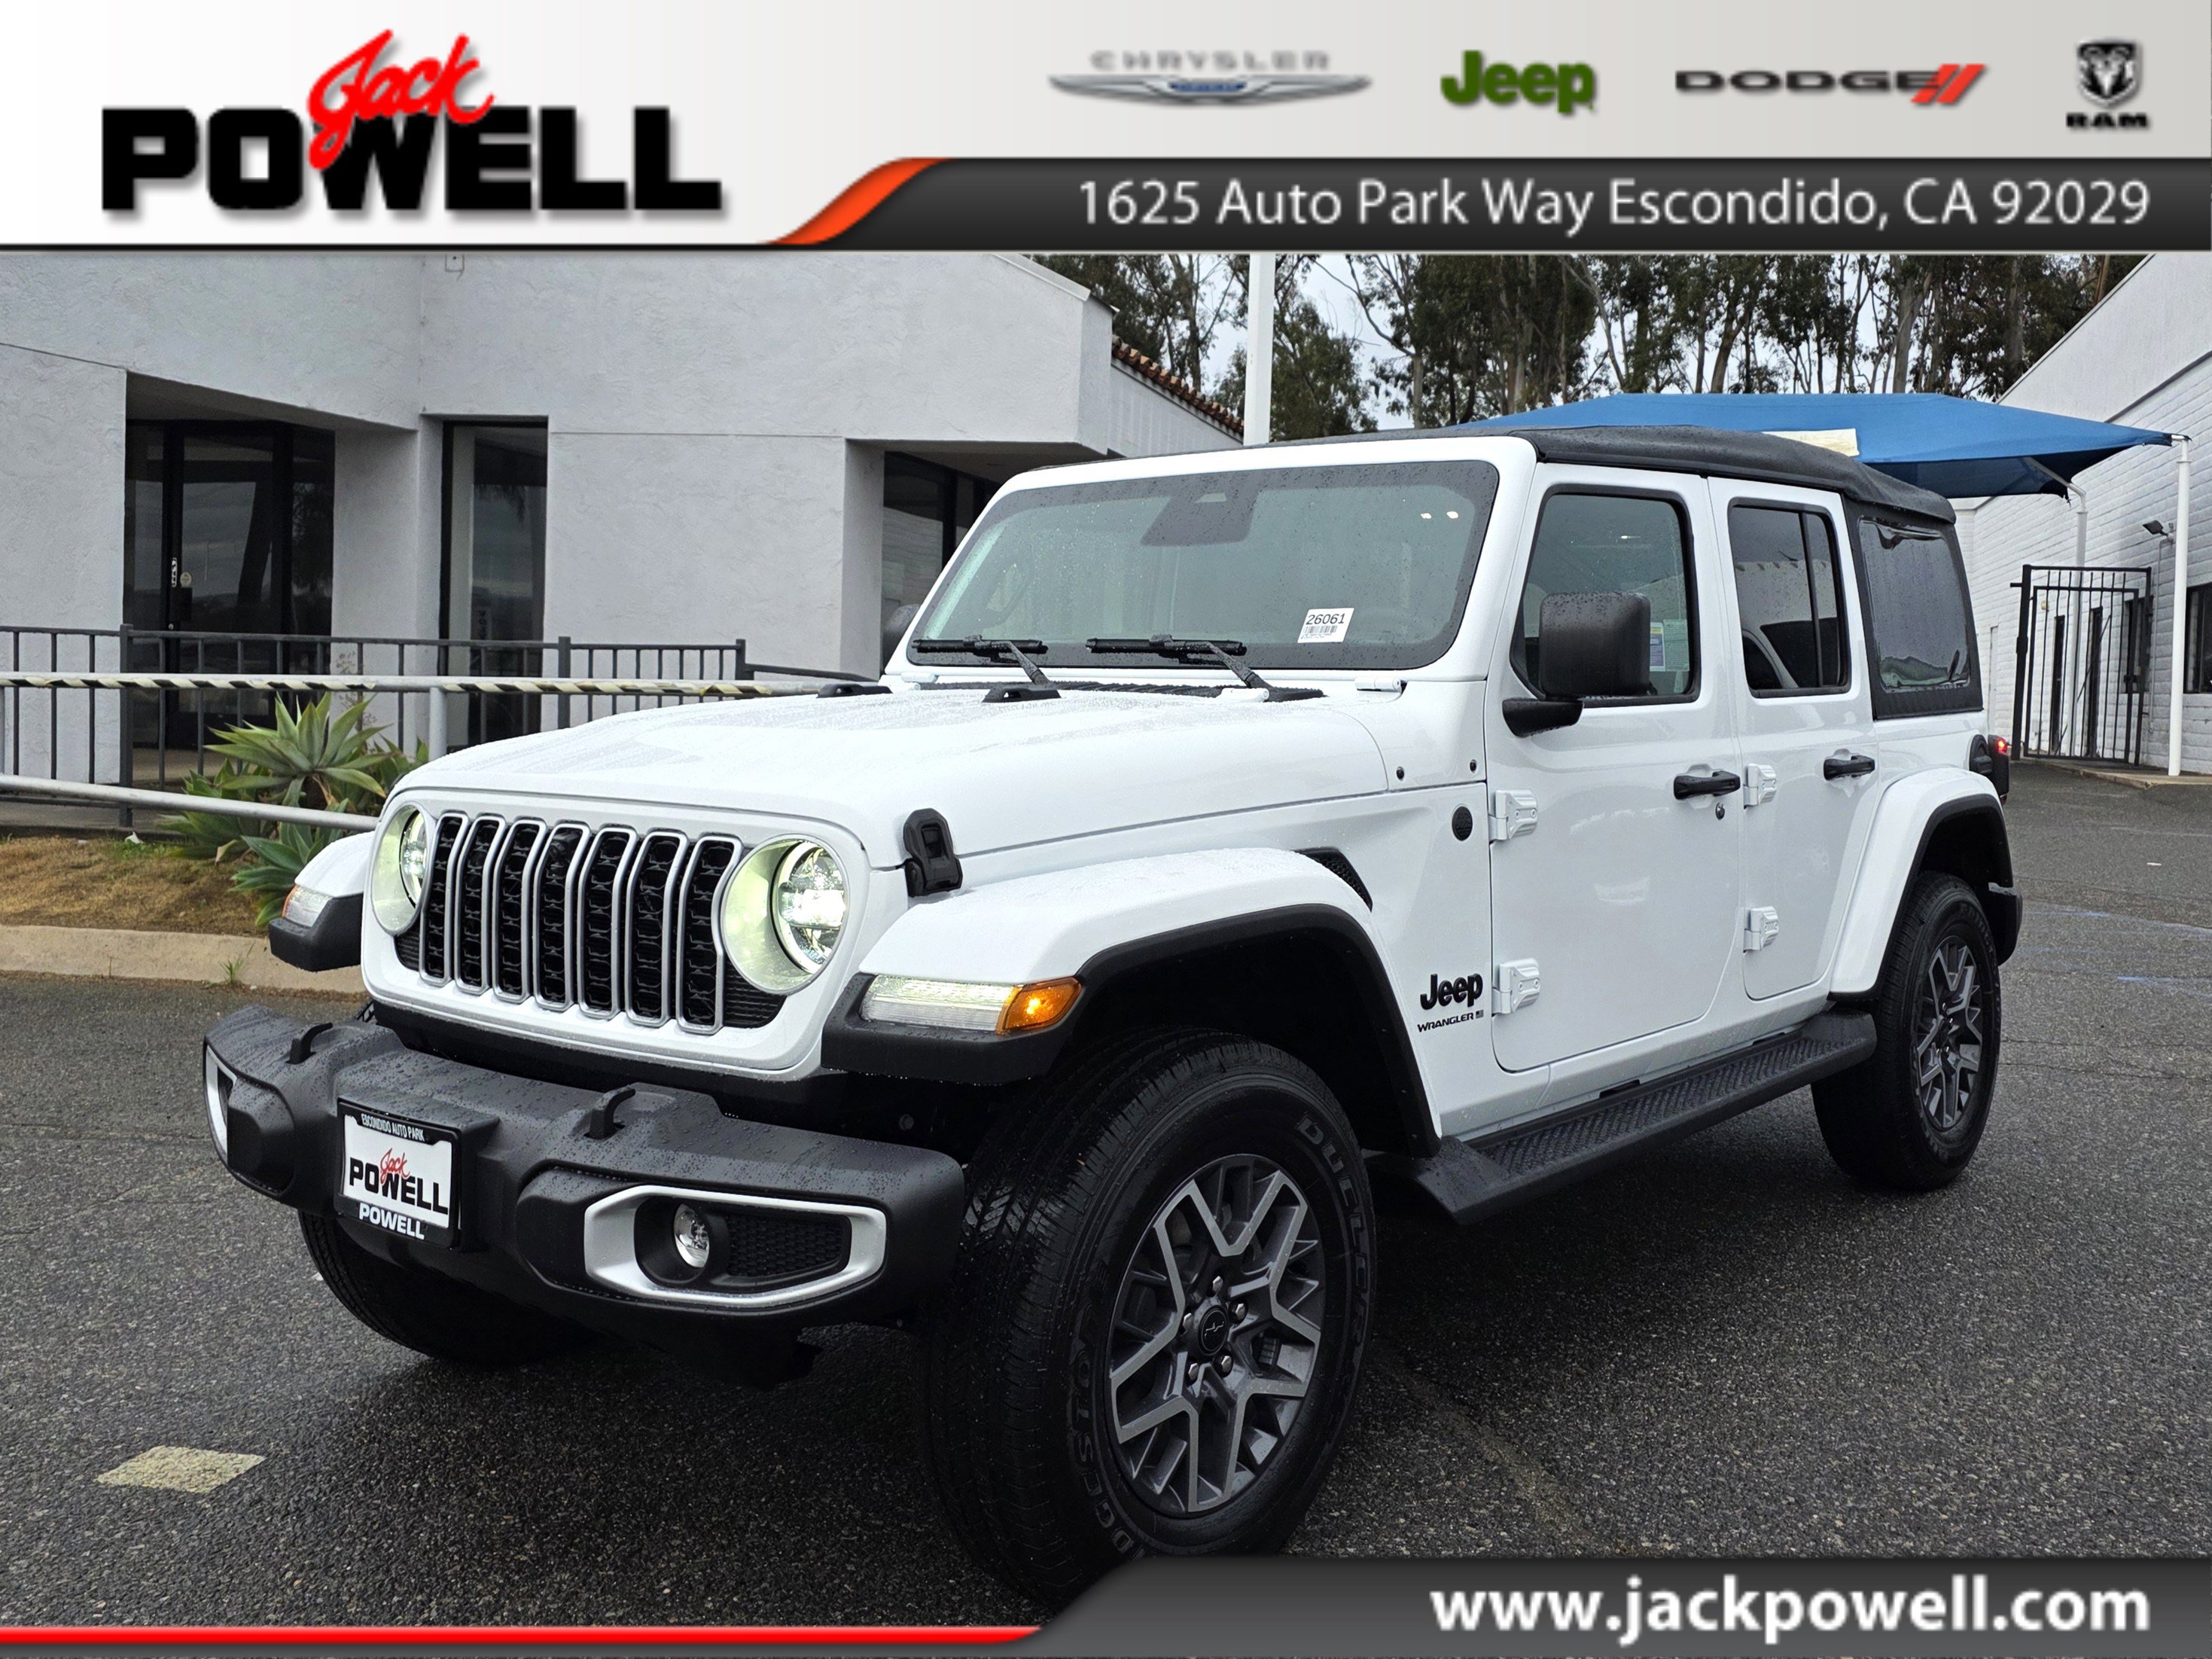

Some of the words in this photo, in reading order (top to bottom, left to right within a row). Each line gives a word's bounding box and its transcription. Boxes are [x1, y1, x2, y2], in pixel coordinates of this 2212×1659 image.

[1306, 612, 1346, 625] 26061
[1420, 972, 1483, 1011] Jeep
[1417, 1012, 1473, 1032] WRANGLER
[361, 1113, 392, 1133] ESCONDIDO
[392, 1122, 407, 1138] AUTO
[407, 1126, 425, 1142] PARK
[380, 1148, 410, 1185] Jack
[349, 1157, 448, 1215] POWELL
[359, 1203, 425, 1240] POWELL
